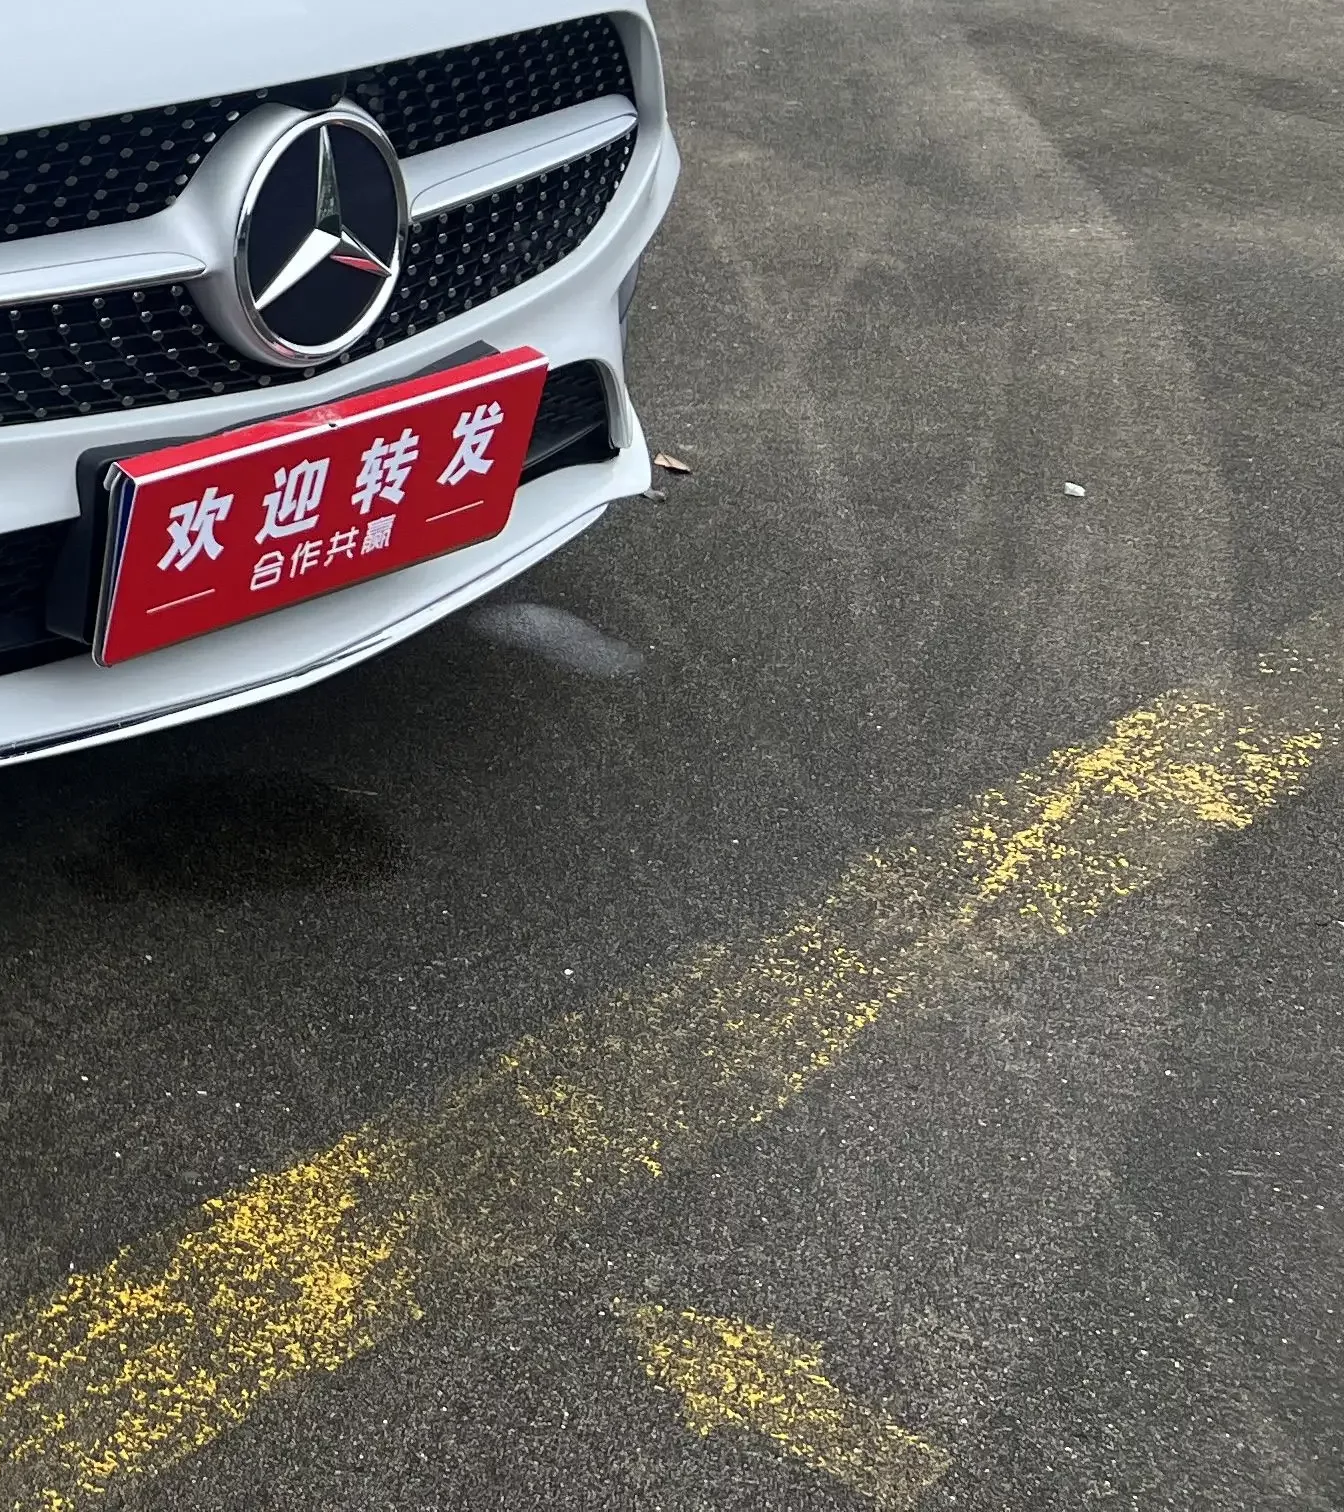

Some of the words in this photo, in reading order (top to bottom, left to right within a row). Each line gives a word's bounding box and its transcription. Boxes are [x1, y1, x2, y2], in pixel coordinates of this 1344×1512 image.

[157, 400, 504, 572] 欢迎转发
[250, 514, 396, 592] 合作共赢
